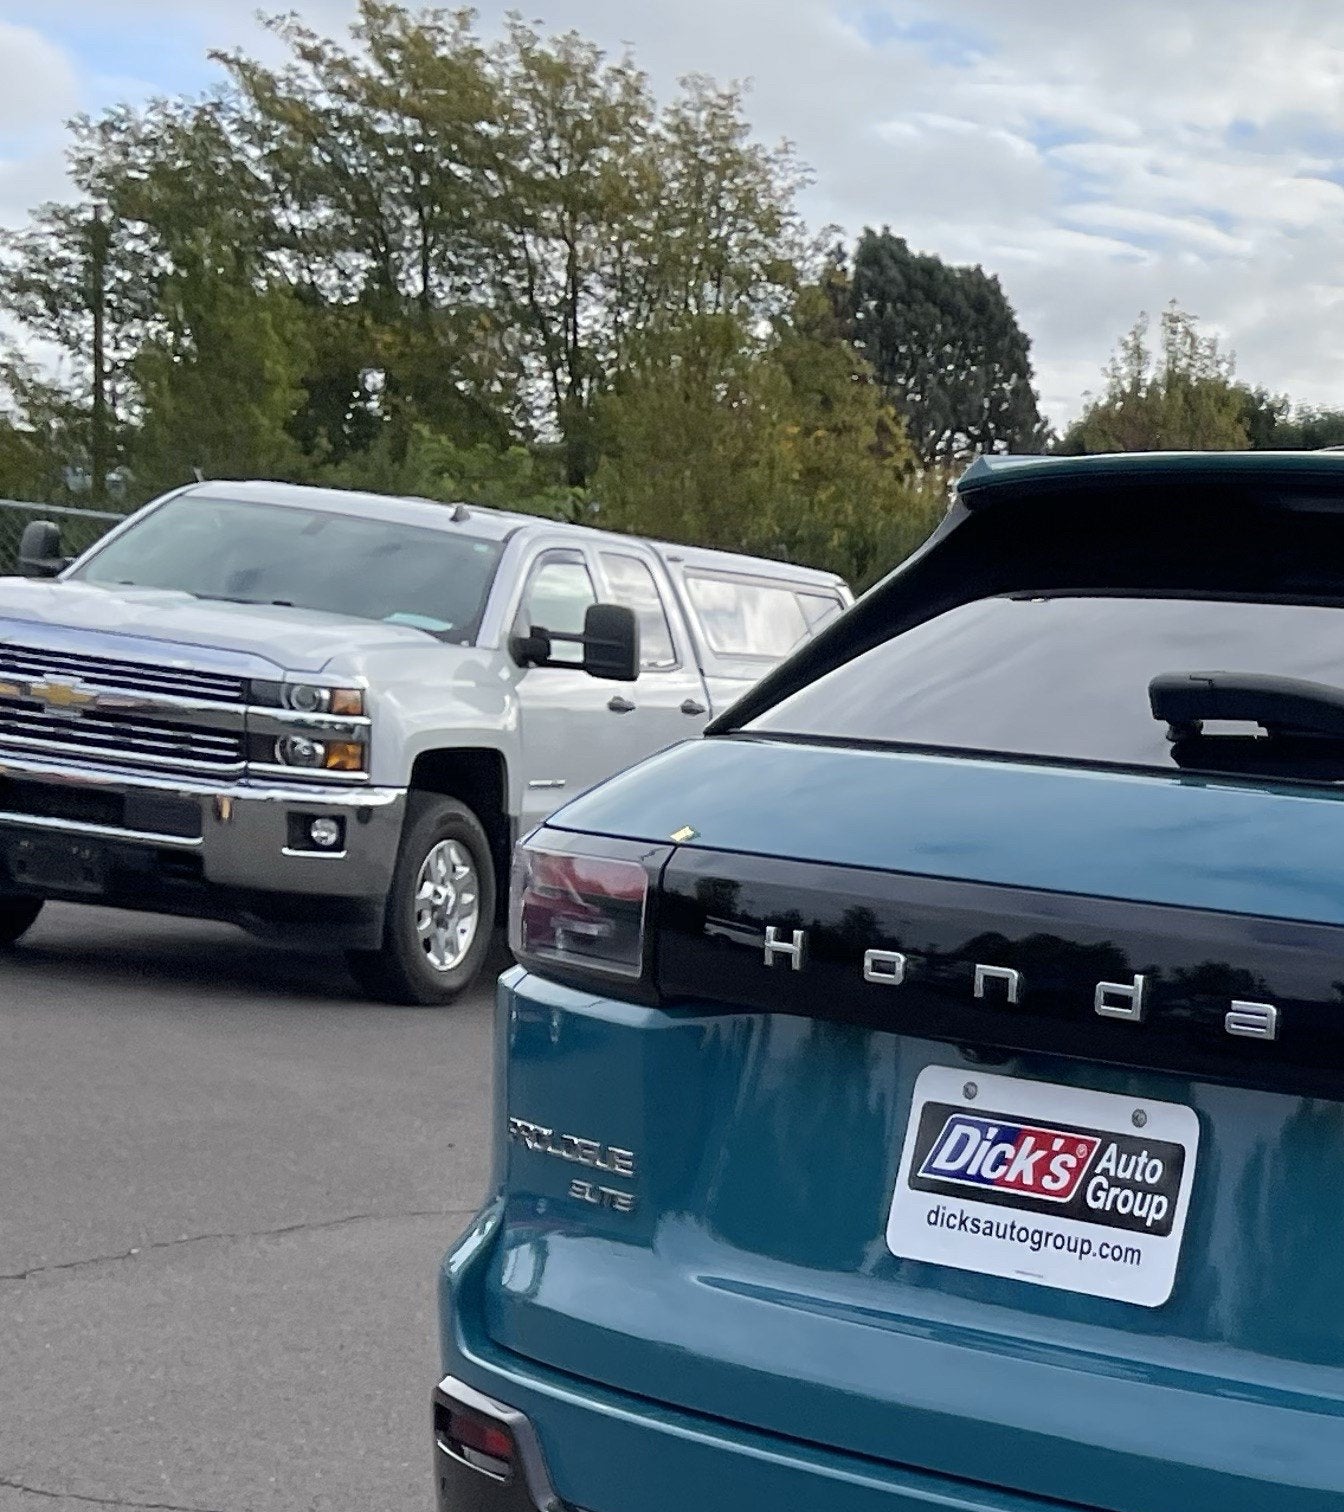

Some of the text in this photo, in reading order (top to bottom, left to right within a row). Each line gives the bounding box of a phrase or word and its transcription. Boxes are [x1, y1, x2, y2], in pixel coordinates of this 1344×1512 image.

[763, 926, 1278, 1040] Honda
[932, 1124, 1078, 1191] Dick's
[1094, 1143, 1163, 1185] Auto
[1086, 1176, 1169, 1226] Group
[926, 1205, 1142, 1266] dicksautogroup.com
